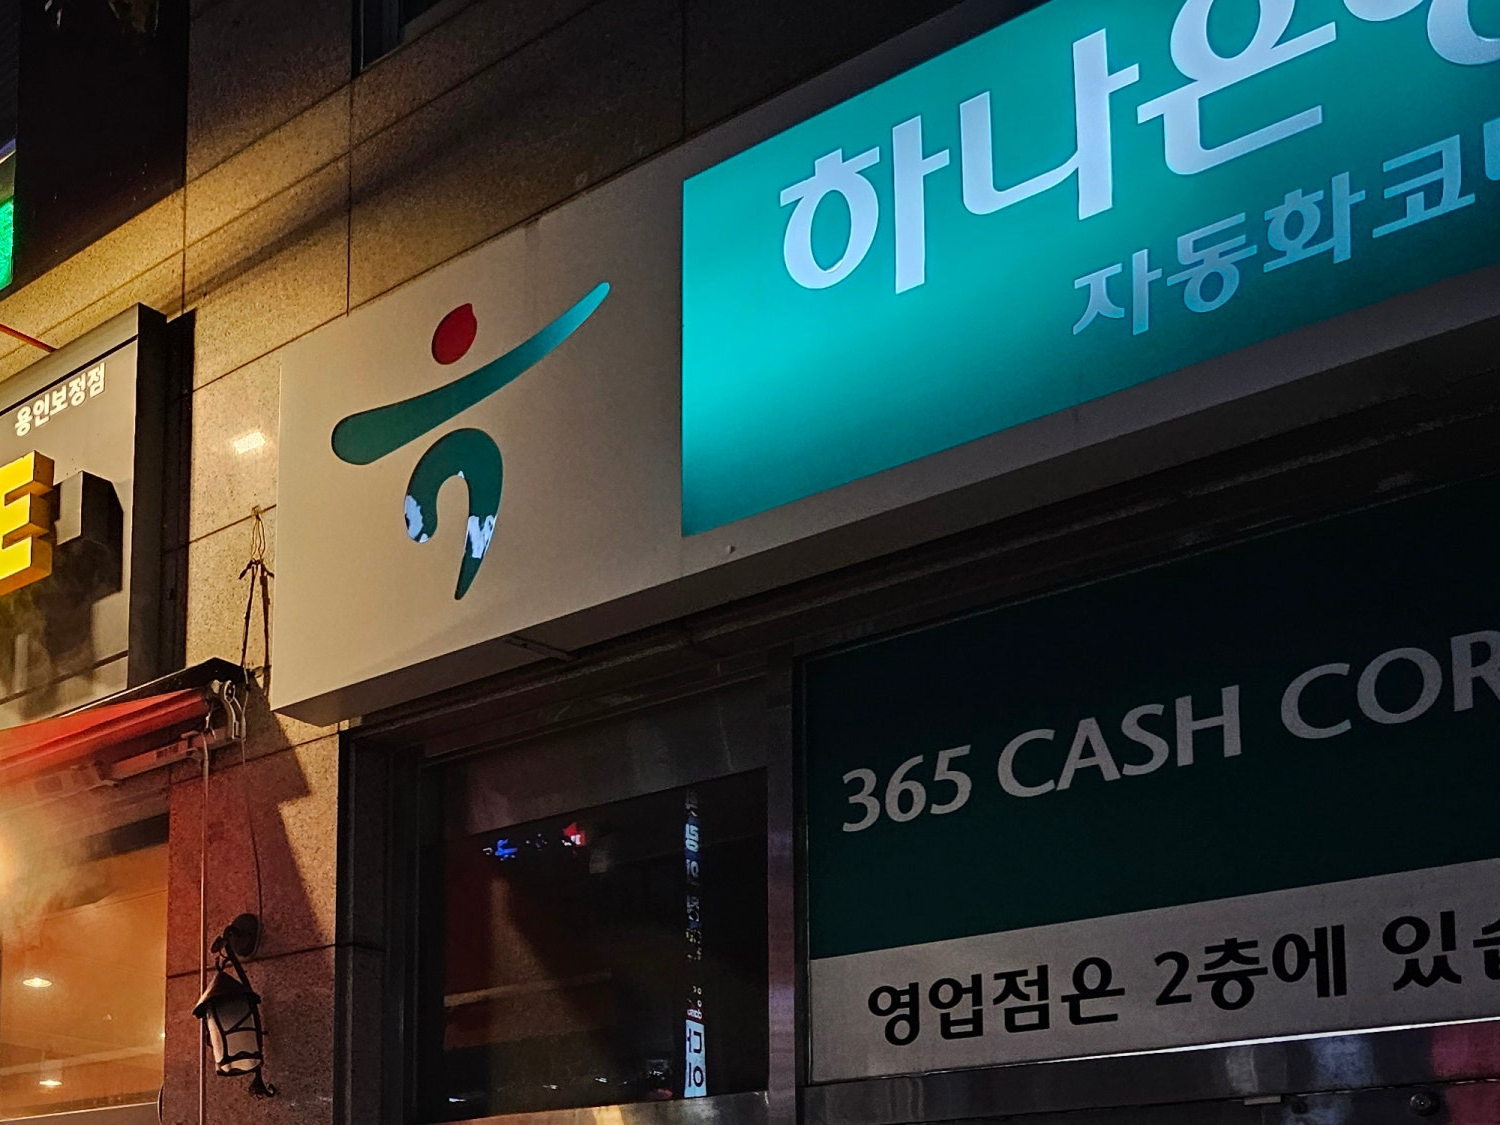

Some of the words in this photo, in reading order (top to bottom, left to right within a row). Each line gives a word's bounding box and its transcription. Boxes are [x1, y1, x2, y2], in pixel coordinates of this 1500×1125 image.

[1073, 119, 1500, 334] 자동화코
[14, 364, 106, 437] 용인보정점
[842, 744, 972, 833] 365
[998, 685, 1241, 798] CASH
[867, 956, 1125, 1047] 영업점은
[1154, 924, 1348, 1010] 2층에
